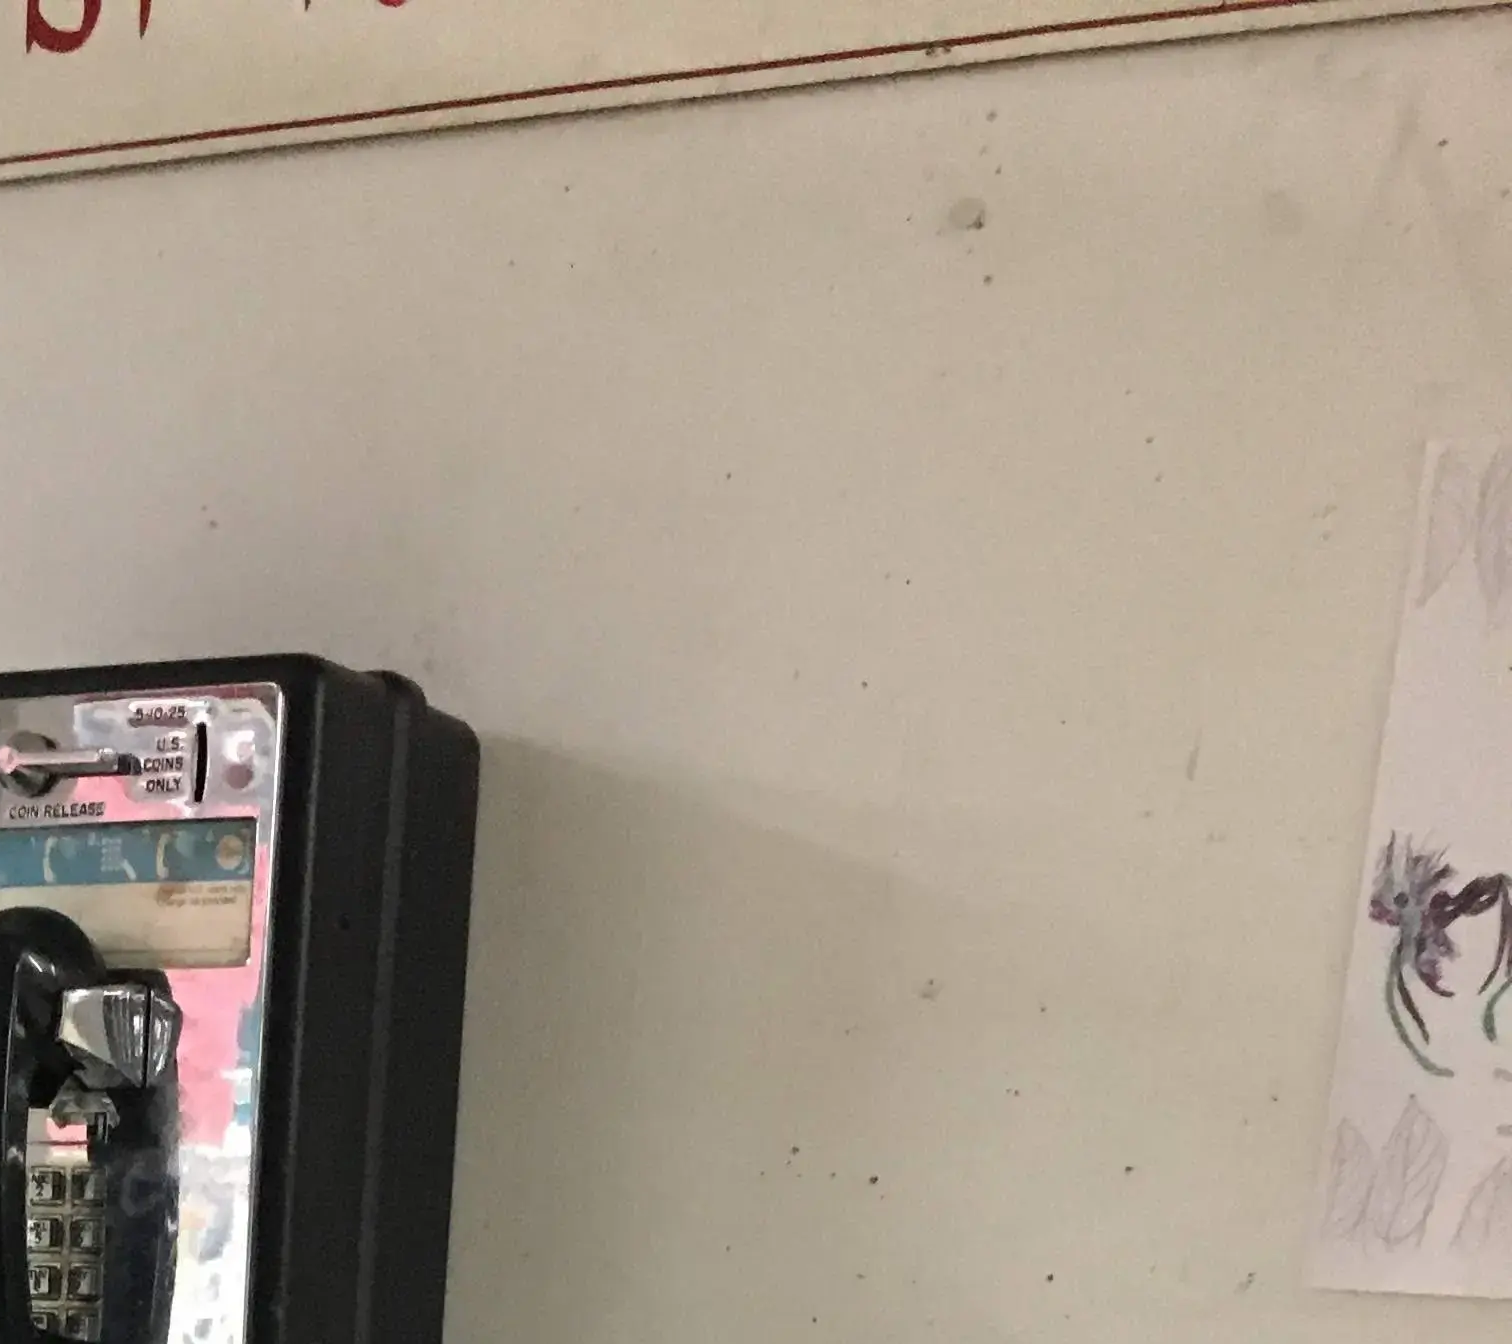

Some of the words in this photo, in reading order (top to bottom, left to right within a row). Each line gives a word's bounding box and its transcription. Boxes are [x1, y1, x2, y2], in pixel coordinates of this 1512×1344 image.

[144, 756, 183, 773] COINS
[145, 777, 181, 793] ONLY
[9, 804, 39, 819] COIN
[44, 801, 105, 818] RELEASE
